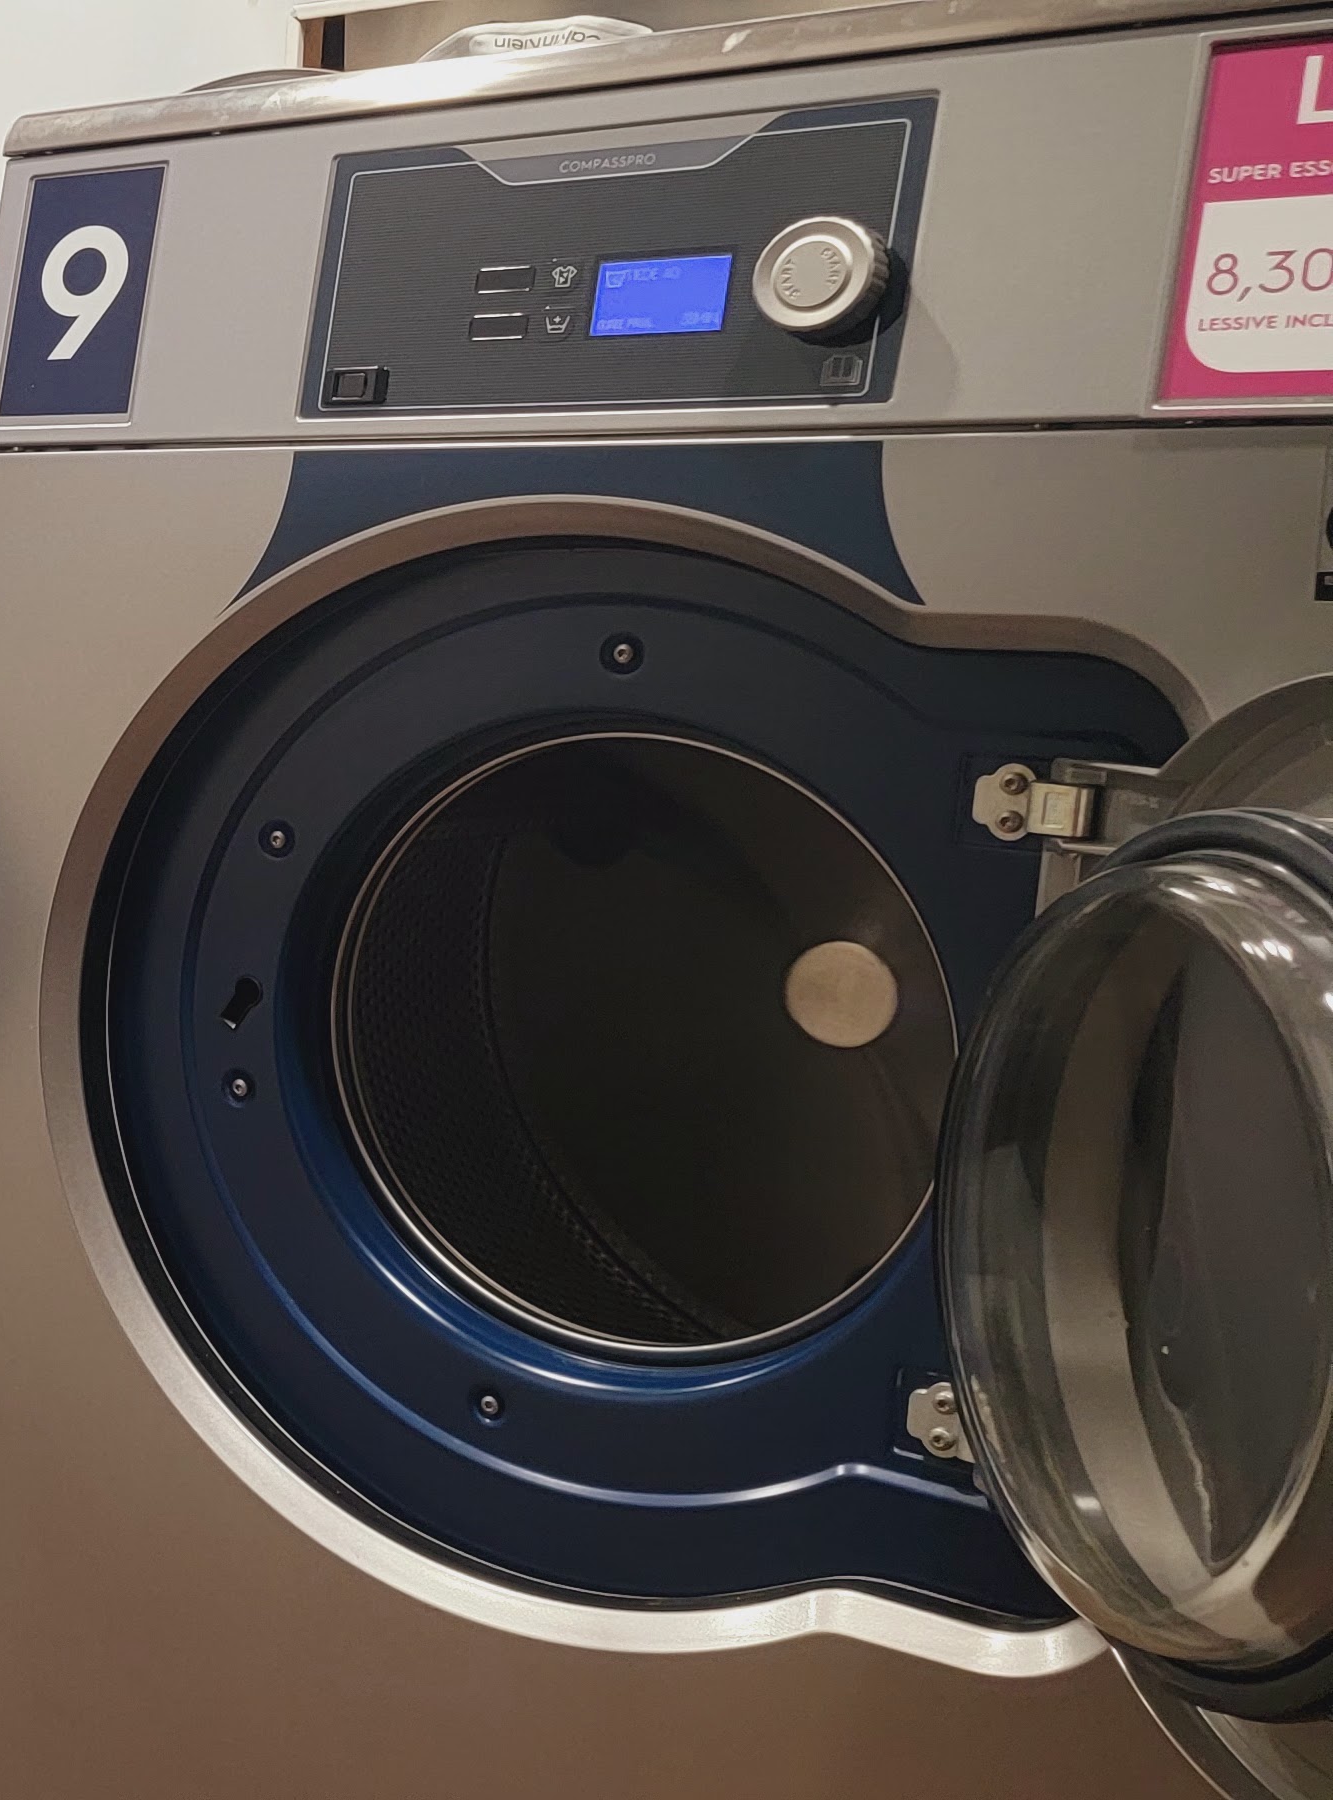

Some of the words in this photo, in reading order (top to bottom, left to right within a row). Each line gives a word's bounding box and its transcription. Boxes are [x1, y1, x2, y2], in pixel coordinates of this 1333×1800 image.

[1297, 55, 1333, 125] L
[559, 153, 656, 173] COMPASSPRO
[1207, 163, 1282, 184] SUPER
[1290, 160, 1333, 178] ESS
[41, 225, 129, 361] 9
[1207, 248, 1333, 302] 8,30
[1198, 315, 1278, 332] LESSIVE
